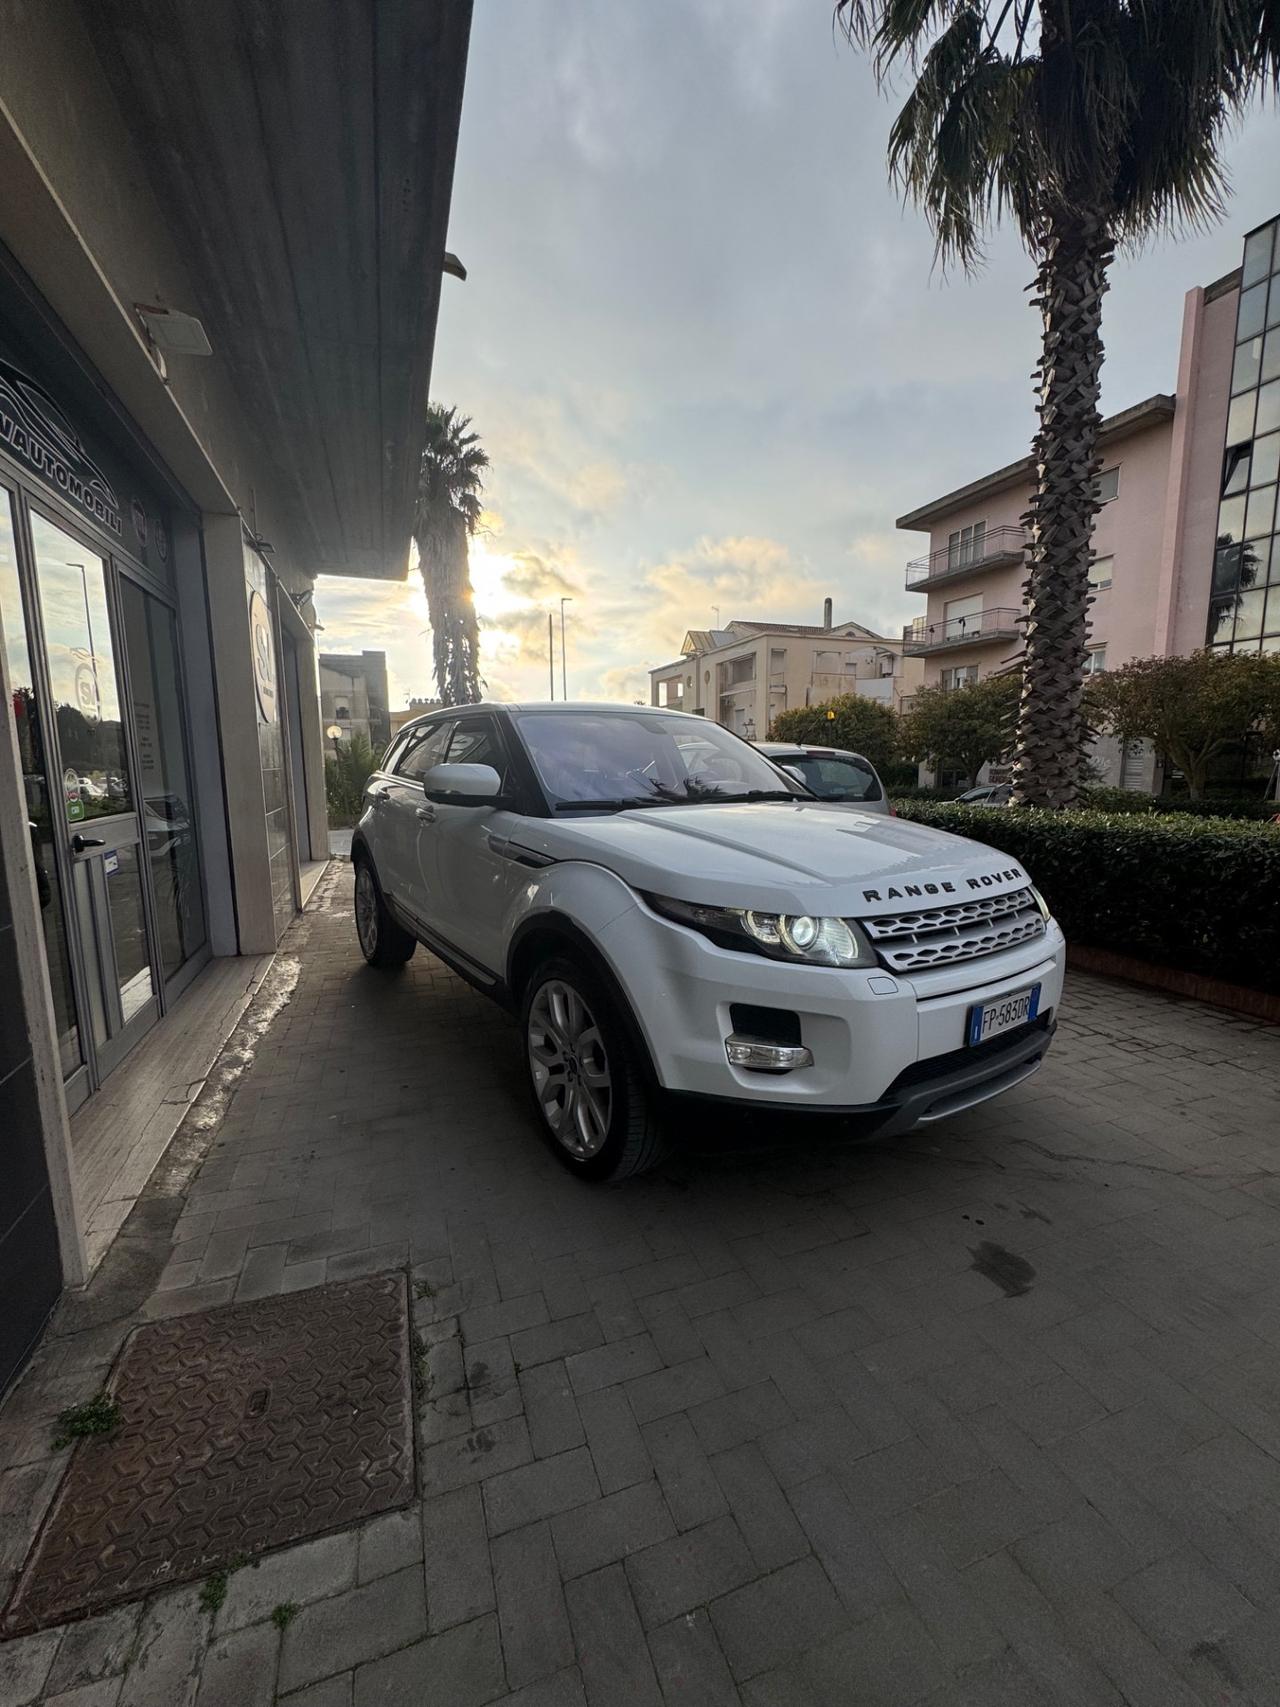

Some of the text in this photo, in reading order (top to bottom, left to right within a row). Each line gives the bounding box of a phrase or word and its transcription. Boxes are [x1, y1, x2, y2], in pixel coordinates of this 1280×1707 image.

[862, 868, 1022, 902] RANGE ROVER
[982, 1008, 997, 1034] FP
